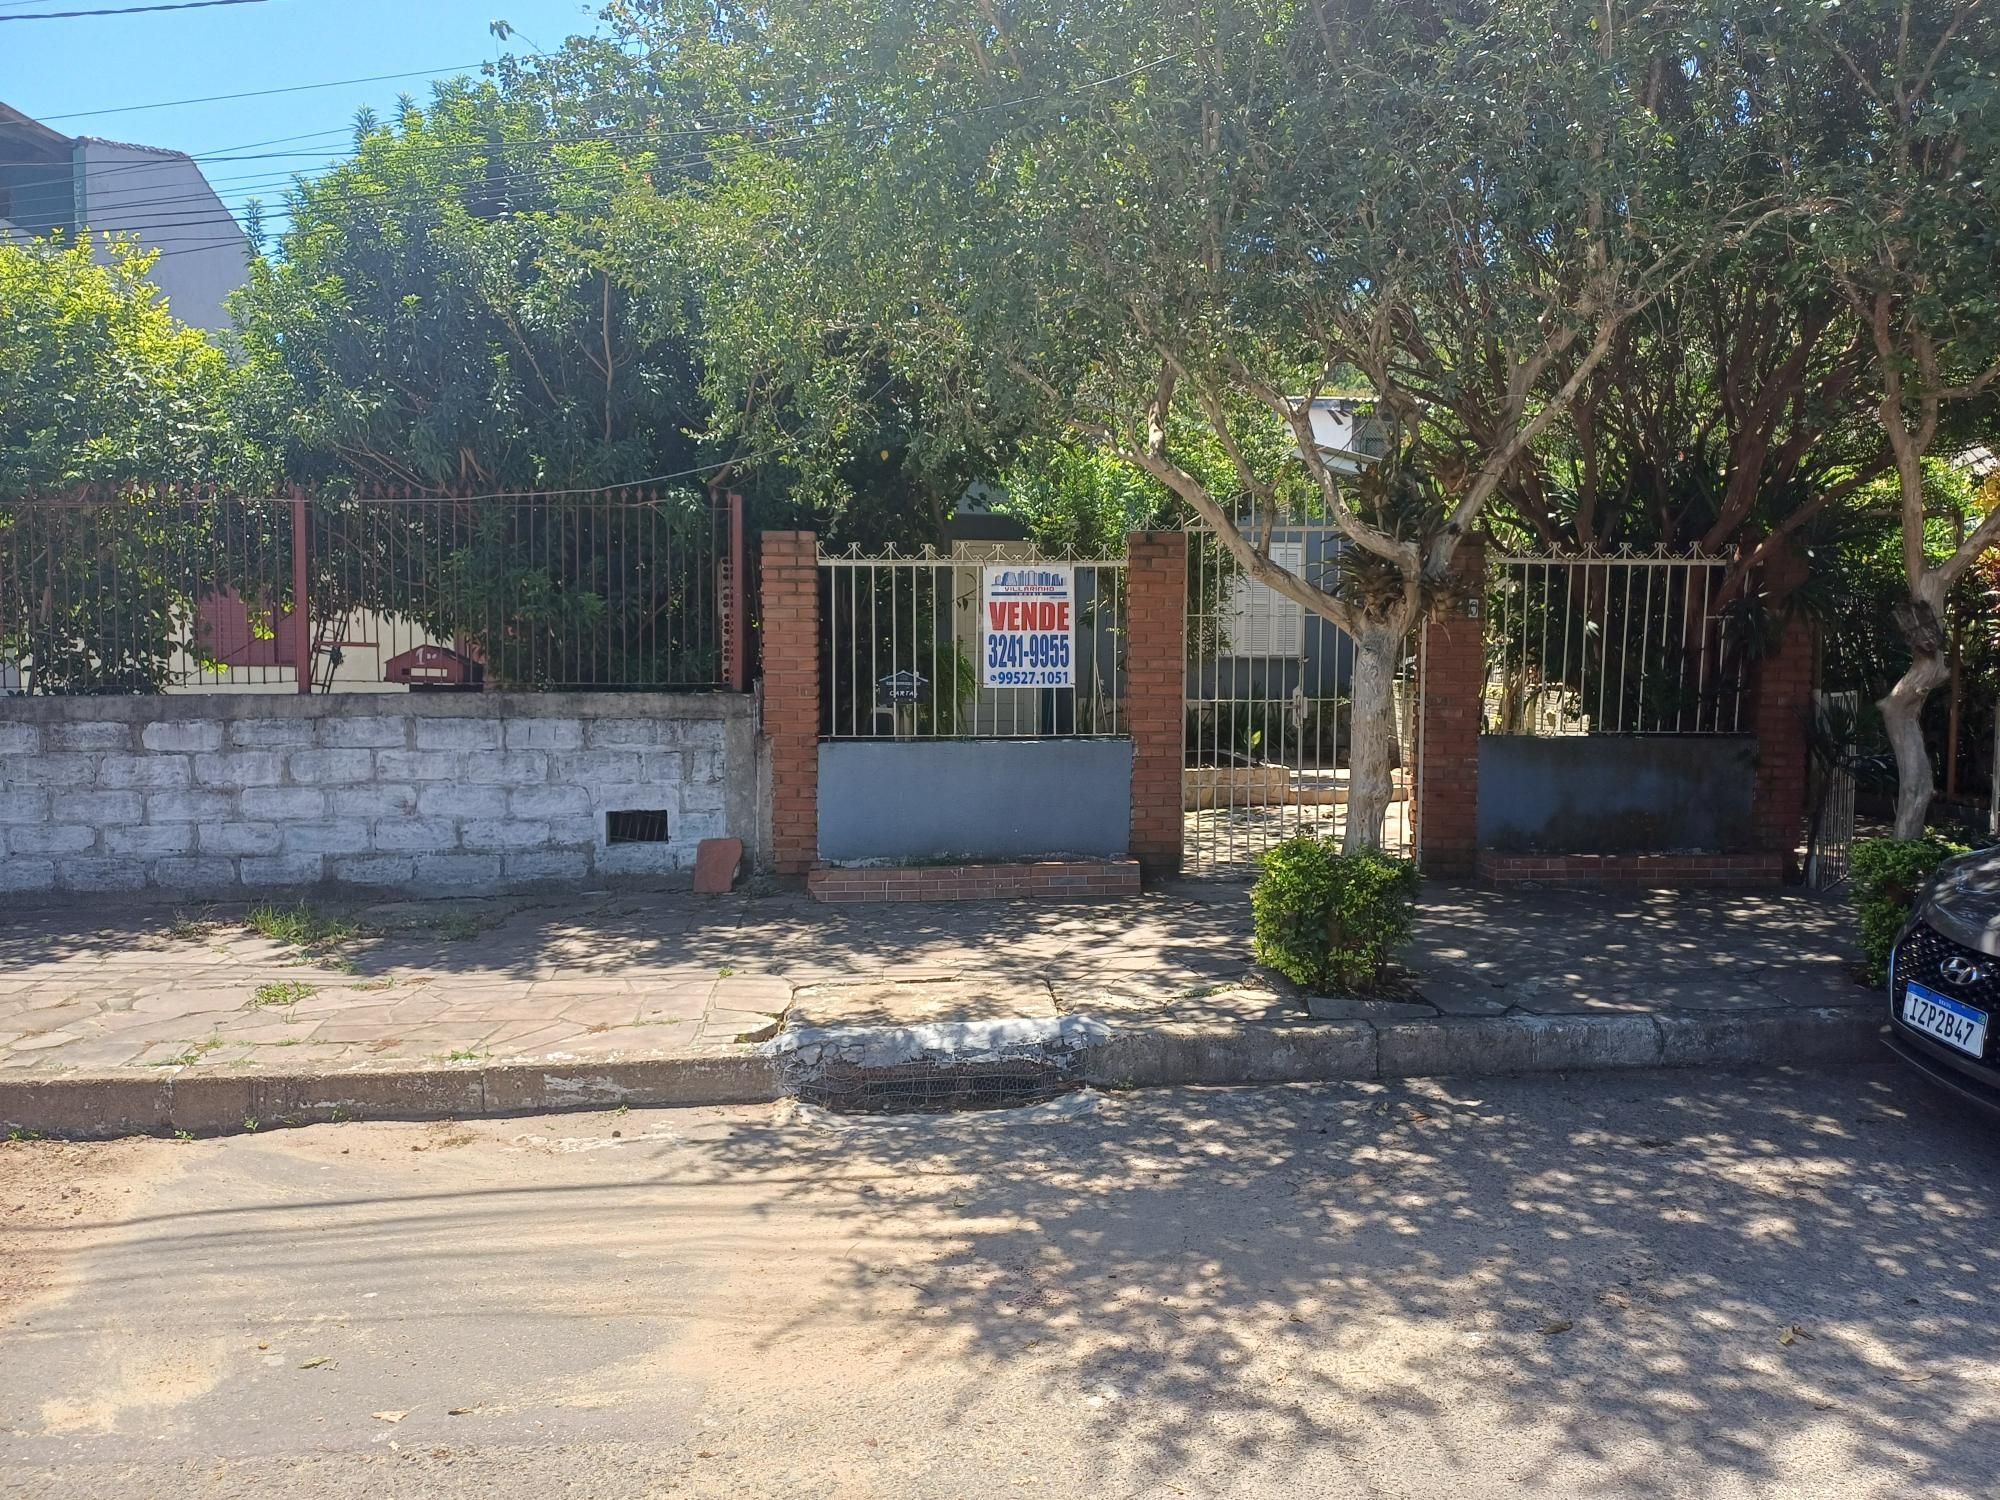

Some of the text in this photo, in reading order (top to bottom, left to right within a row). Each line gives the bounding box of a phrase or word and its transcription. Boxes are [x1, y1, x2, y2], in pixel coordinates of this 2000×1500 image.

[989, 601, 1070, 631] VENDE
[988, 634, 1070, 669] 3241-9955
[998, 671, 1068, 685] 99527.1051
[1909, 998, 1975, 1046] IZP2B47
